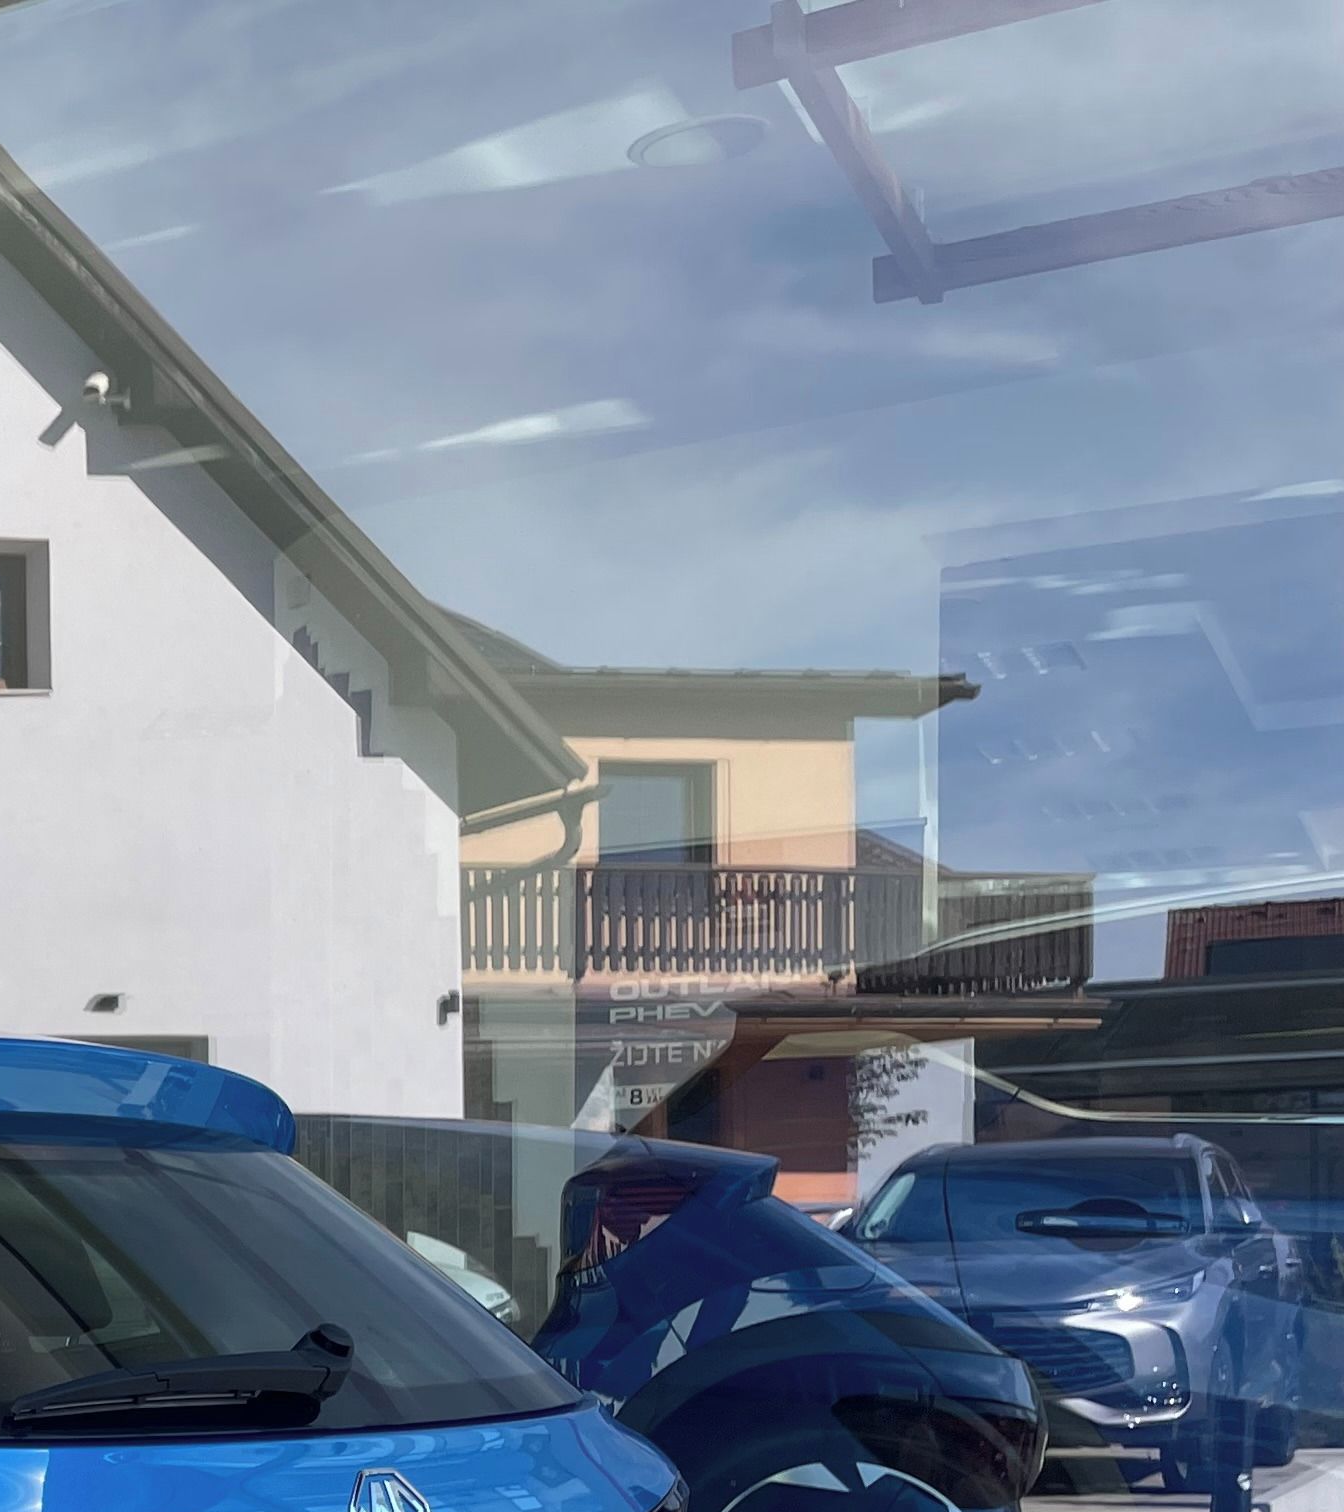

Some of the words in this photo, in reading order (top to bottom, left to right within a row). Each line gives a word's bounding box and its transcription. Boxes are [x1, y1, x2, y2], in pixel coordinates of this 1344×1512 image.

[609, 1001, 725, 1024] PHEV
[610, 1041, 683, 1067] ŽIJTE
[630, 1088, 643, 1105] 8
